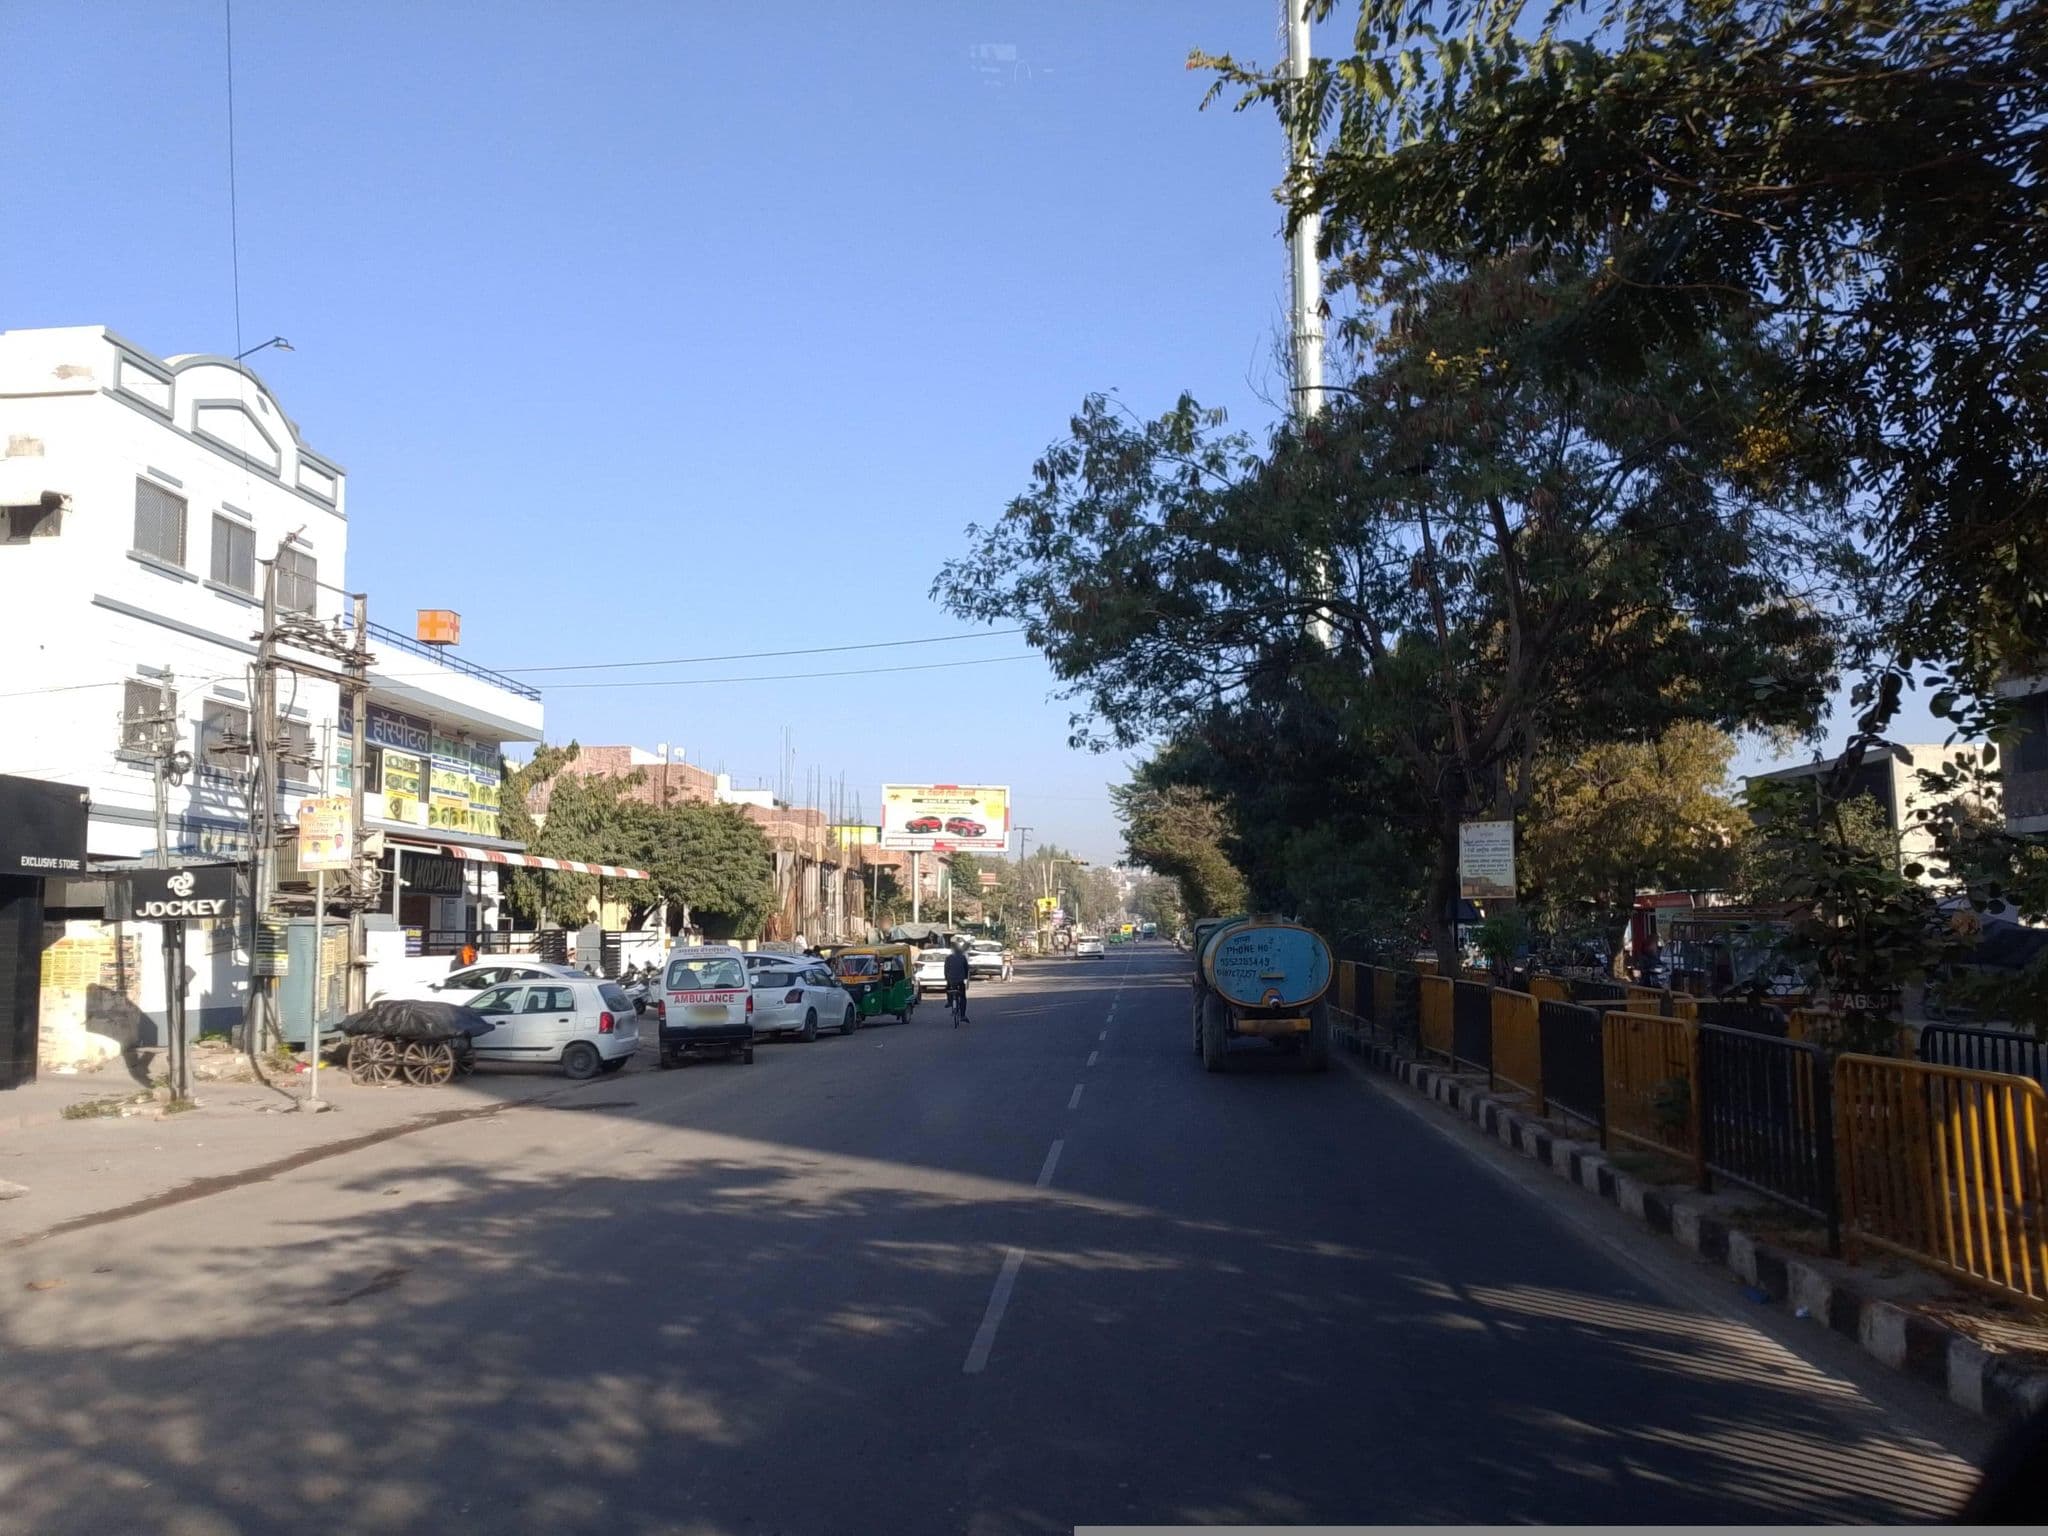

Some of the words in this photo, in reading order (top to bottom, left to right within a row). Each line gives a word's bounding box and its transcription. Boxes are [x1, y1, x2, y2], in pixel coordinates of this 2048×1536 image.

[372, 711, 429, 751] हॉस्पीटल
[21, 856, 58, 868] EXCLUSIVE
[58, 859, 81, 870] STORE
[414, 857, 462, 891] HOSPITAL
[136, 899, 226, 917] JOCKEY
[1226, 944, 1255, 954] PHONE
[674, 994, 735, 1004] AMBULANCE
